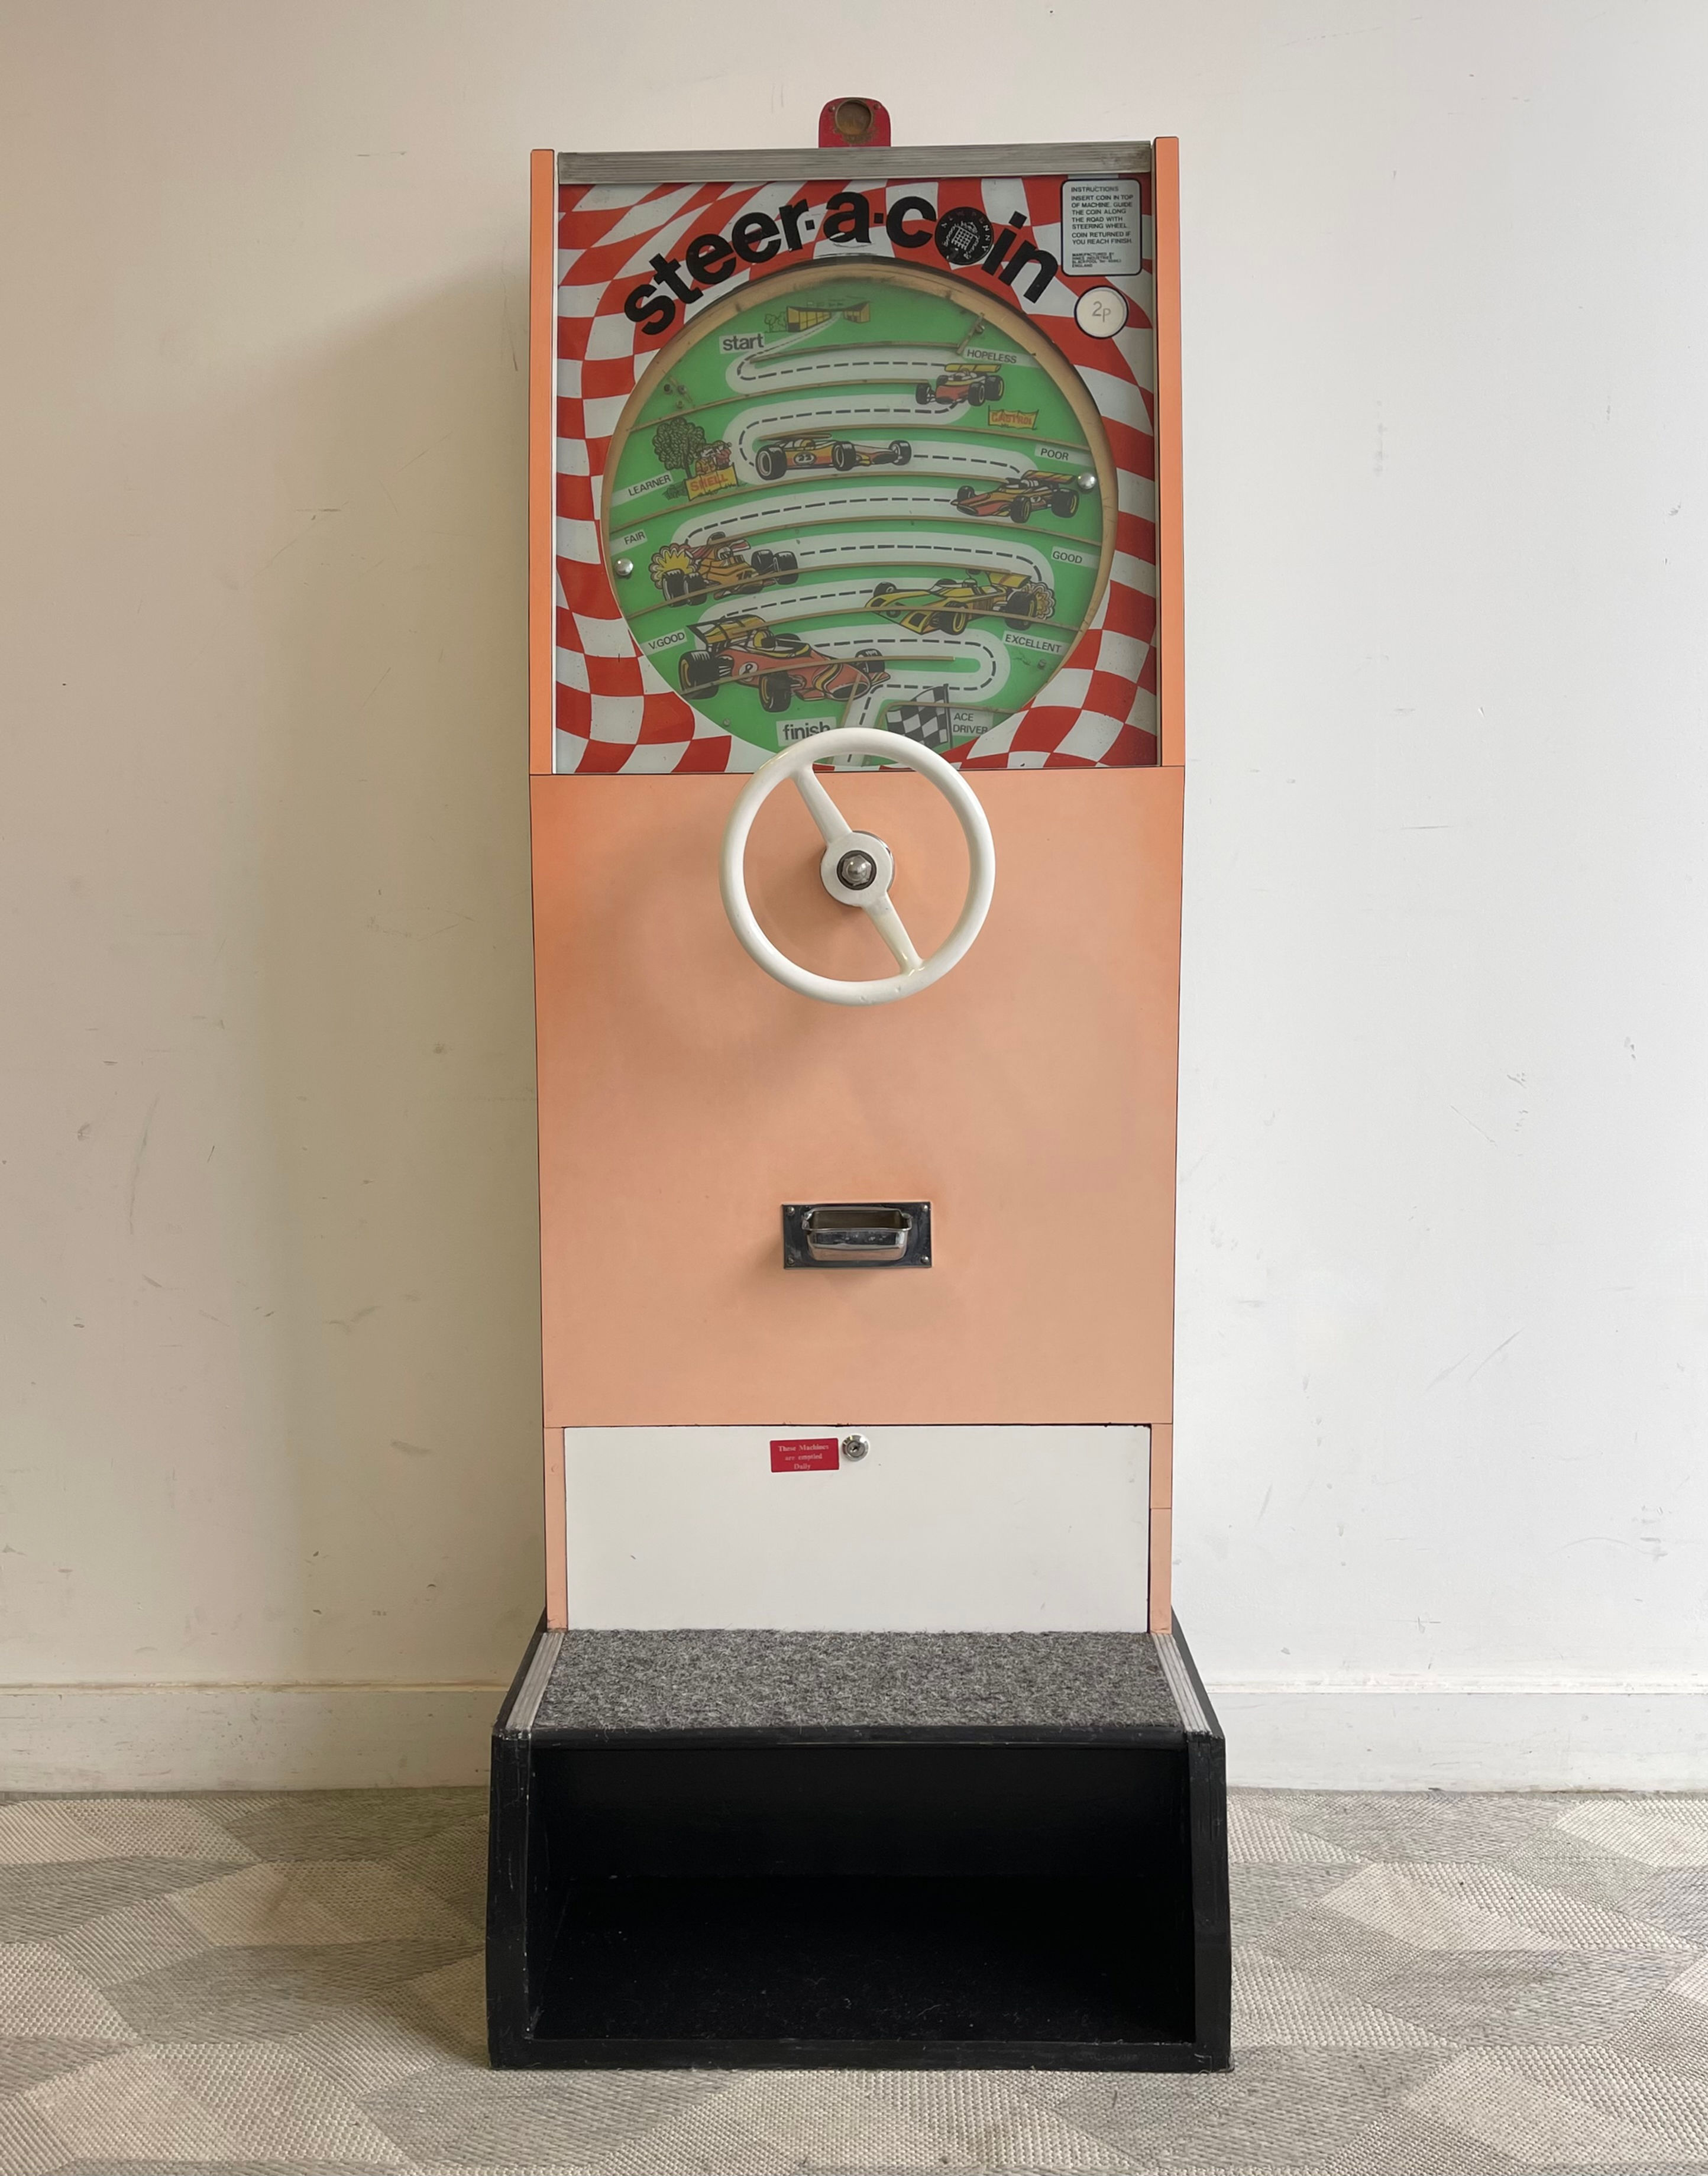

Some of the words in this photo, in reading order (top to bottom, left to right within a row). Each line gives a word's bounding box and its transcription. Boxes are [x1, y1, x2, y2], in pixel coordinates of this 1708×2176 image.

[1092, 301, 1111, 322] 2p
[723, 333, 764, 351] start
[967, 349, 1017, 364] HOPELESS
[991, 412, 1033, 425] CASTROL
[1041, 448, 1069, 460] POOR
[628, 474, 672, 496] LEARNER
[690, 474, 729, 492] SHELL
[624, 531, 646, 545] FAIR
[1053, 551, 1083, 564] GOOD
[648, 632, 685, 650] V.GOOD
[1005, 634, 1062, 653] EXCELLENT
[953, 713, 974, 722] ACE
[782, 721, 831, 741] finish
[953, 724, 989, 734] DRIVER
[798, 1453, 823, 1462] emptied
